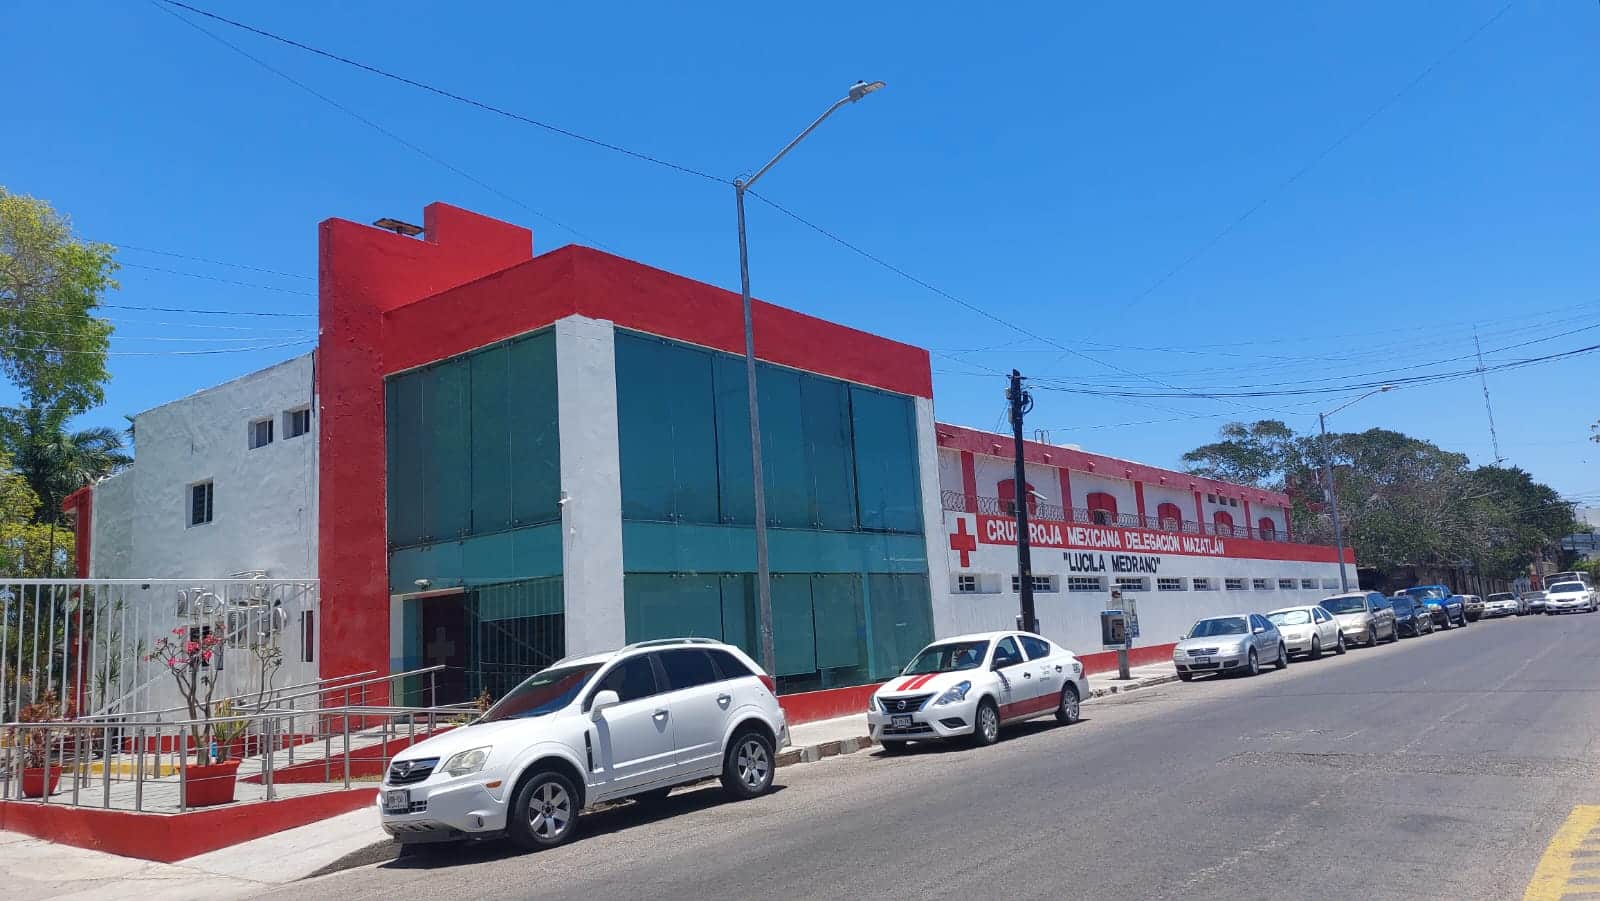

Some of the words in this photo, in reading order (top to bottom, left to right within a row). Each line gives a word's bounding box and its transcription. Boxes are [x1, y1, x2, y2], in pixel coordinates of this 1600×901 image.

[1028, 522, 1063, 545] ROJA
[1066, 526, 1121, 548] MEXICANA
[1125, 531, 1180, 552] DELEGACIÓN
[1183, 535, 1224, 555] MAZATLÁN
[1063, 552, 1106, 572] "LUCILA
[1112, 554, 1160, 574] MEDRANO"
